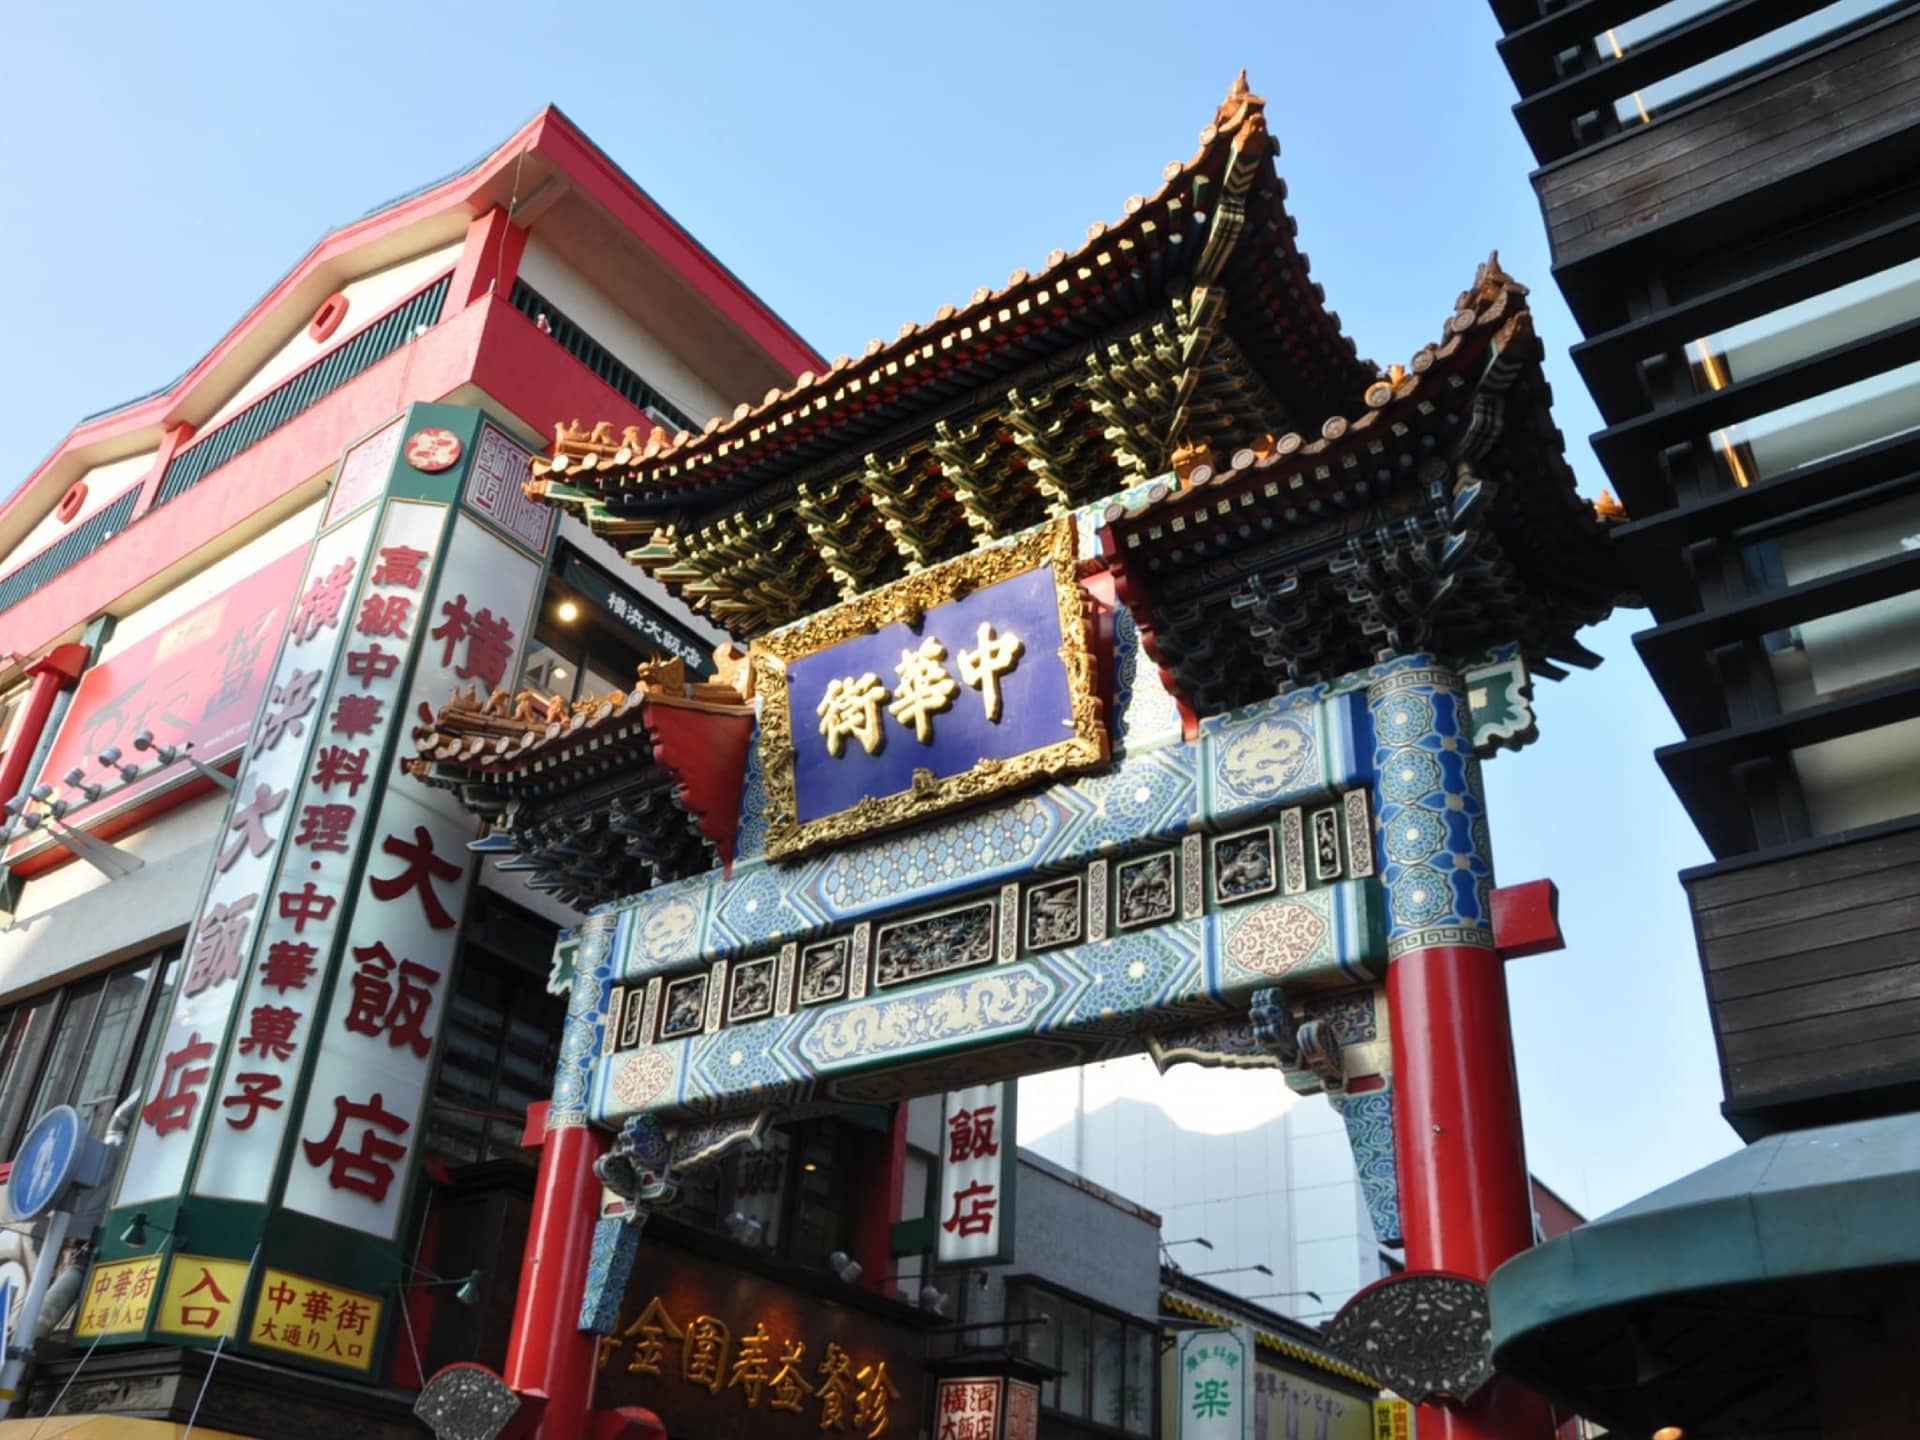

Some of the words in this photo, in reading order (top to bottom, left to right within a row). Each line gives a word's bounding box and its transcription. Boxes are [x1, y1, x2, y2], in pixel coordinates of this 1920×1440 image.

[607, 592, 703, 670] 横浜大飯店
[816, 620, 1021, 757] 中華街
[303, 594, 515, 1202] 横大飯店
[942, 1104, 999, 1239] 飯店
[94, 1265, 157, 1303] 中華街
[180, 1267, 231, 1329] 入口
[268, 1280, 372, 1337] 中華街
[258, 1317, 364, 1359] 大通り入口
[1192, 1377, 1232, 1420] 楽
